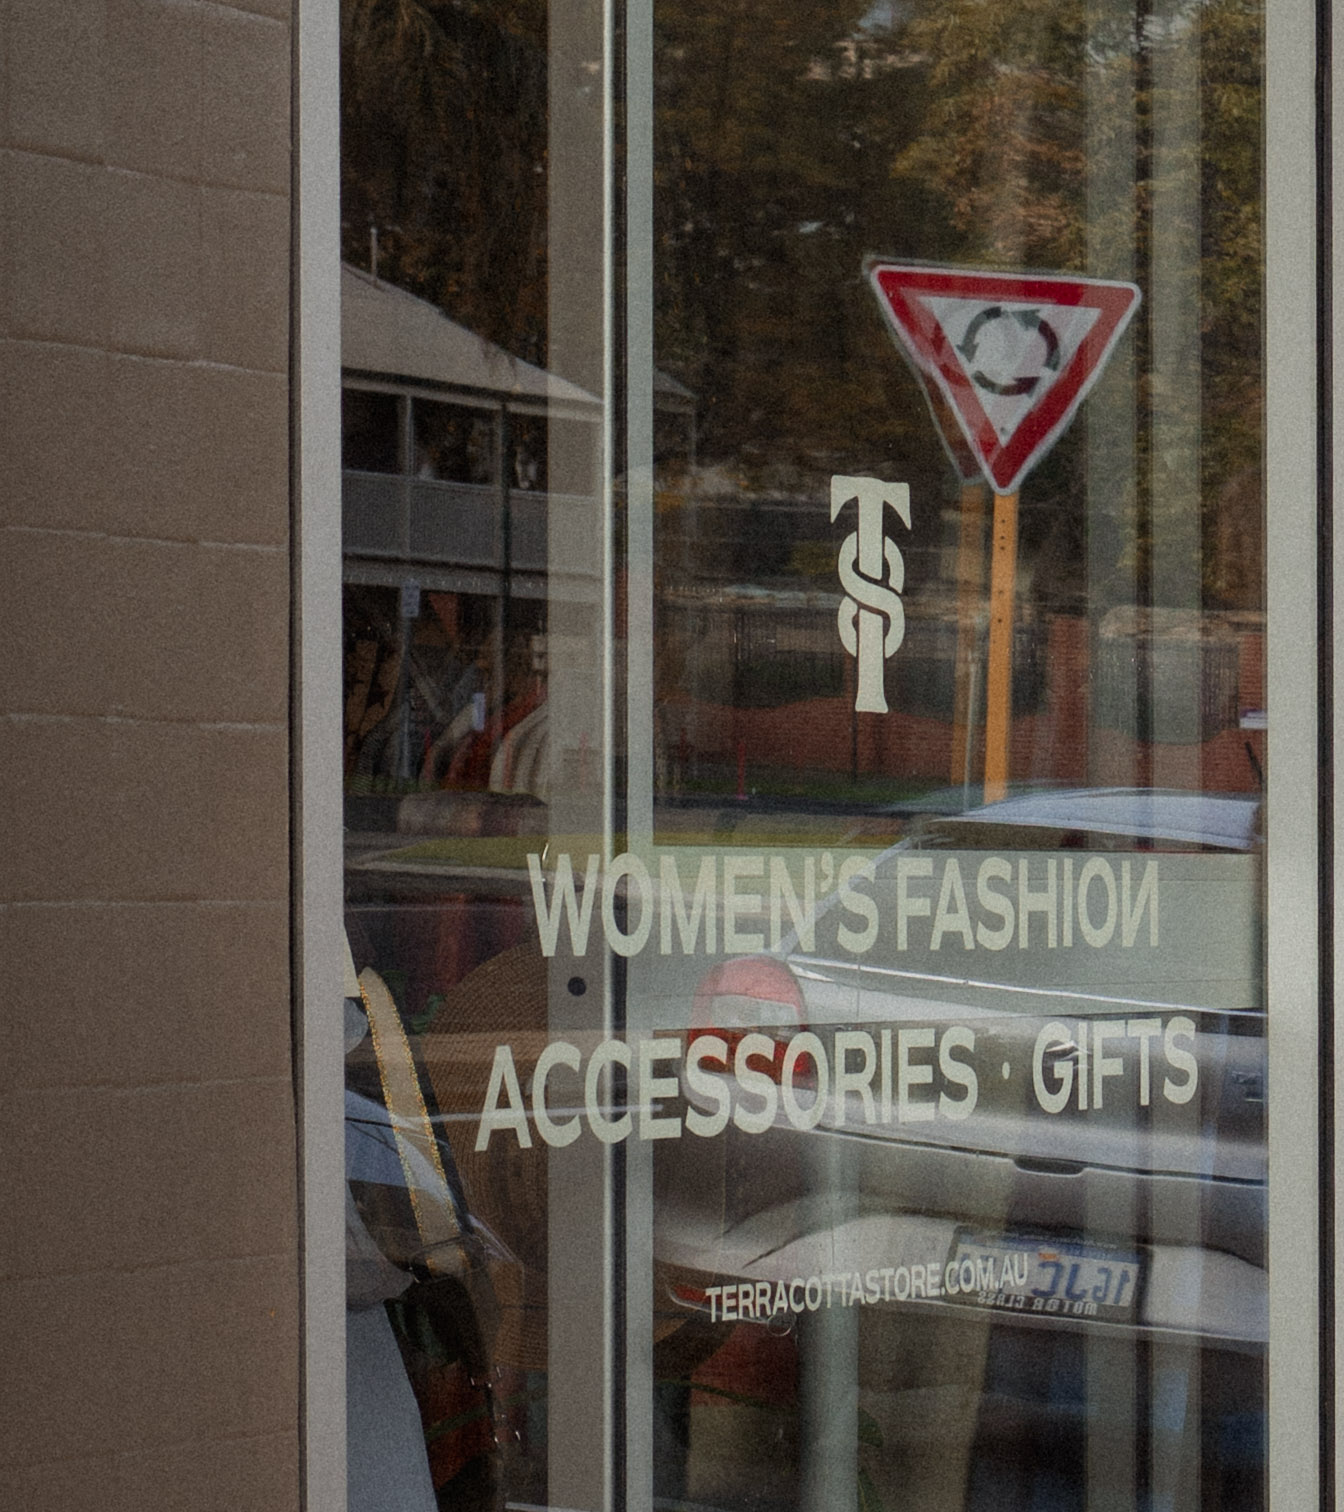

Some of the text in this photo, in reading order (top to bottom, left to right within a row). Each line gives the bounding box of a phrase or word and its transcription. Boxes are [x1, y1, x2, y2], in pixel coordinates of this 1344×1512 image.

[526, 852, 879, 958] WOMEN'S
[474, 1026, 979, 1152] ACCESSORIES
[1033, 1017, 1199, 1114] GIFTS
[705, 1253, 1028, 1323] TERRACOTTASTORE.COM.AU
